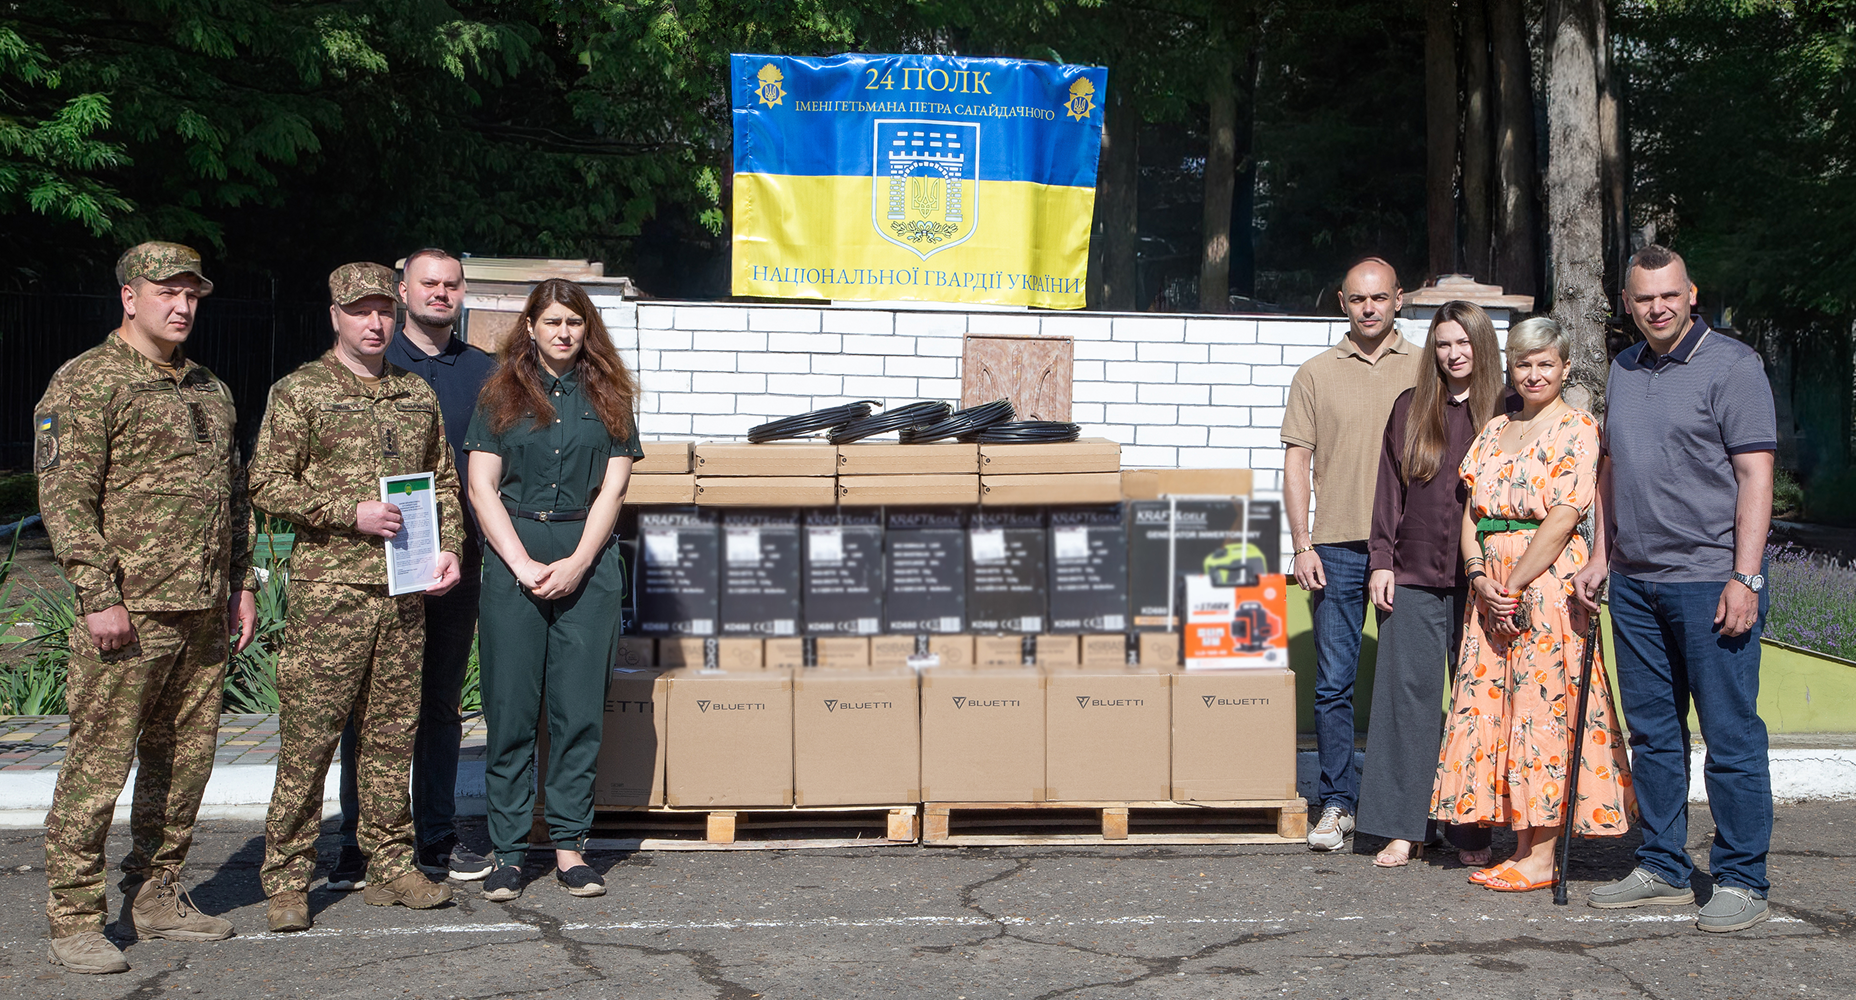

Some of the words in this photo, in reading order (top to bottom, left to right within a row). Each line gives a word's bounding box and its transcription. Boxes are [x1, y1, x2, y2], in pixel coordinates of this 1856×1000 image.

[865, 68, 895, 90] 24
[902, 67, 992, 95] ПОЛК
[795, 100, 832, 112] ІМЕНІ
[834, 101, 906, 113] ГЕТЬМАНА
[909, 102, 952, 115] ПЕТРА
[954, 103, 1055, 122] САГАЙДАЧНОГО
[753, 265, 919, 287] НАЦІОНАЛЬНОЇ
[924, 270, 1003, 292] ГВАРДІЇ
[1007, 273, 1080, 294] УКРАЇНИ
[1136, 511, 1207, 521] KRAF&DELE
[1146, 531, 1196, 539] GENEATOR
[1199, 530, 1261, 539] INWERTORWY
[840, 702, 892, 710] BLUETTI
[1092, 699, 1144, 707] BLUETTI
[1217, 698, 1269, 706] BLUETTI
[713, 703, 765, 711] BLUETTI
